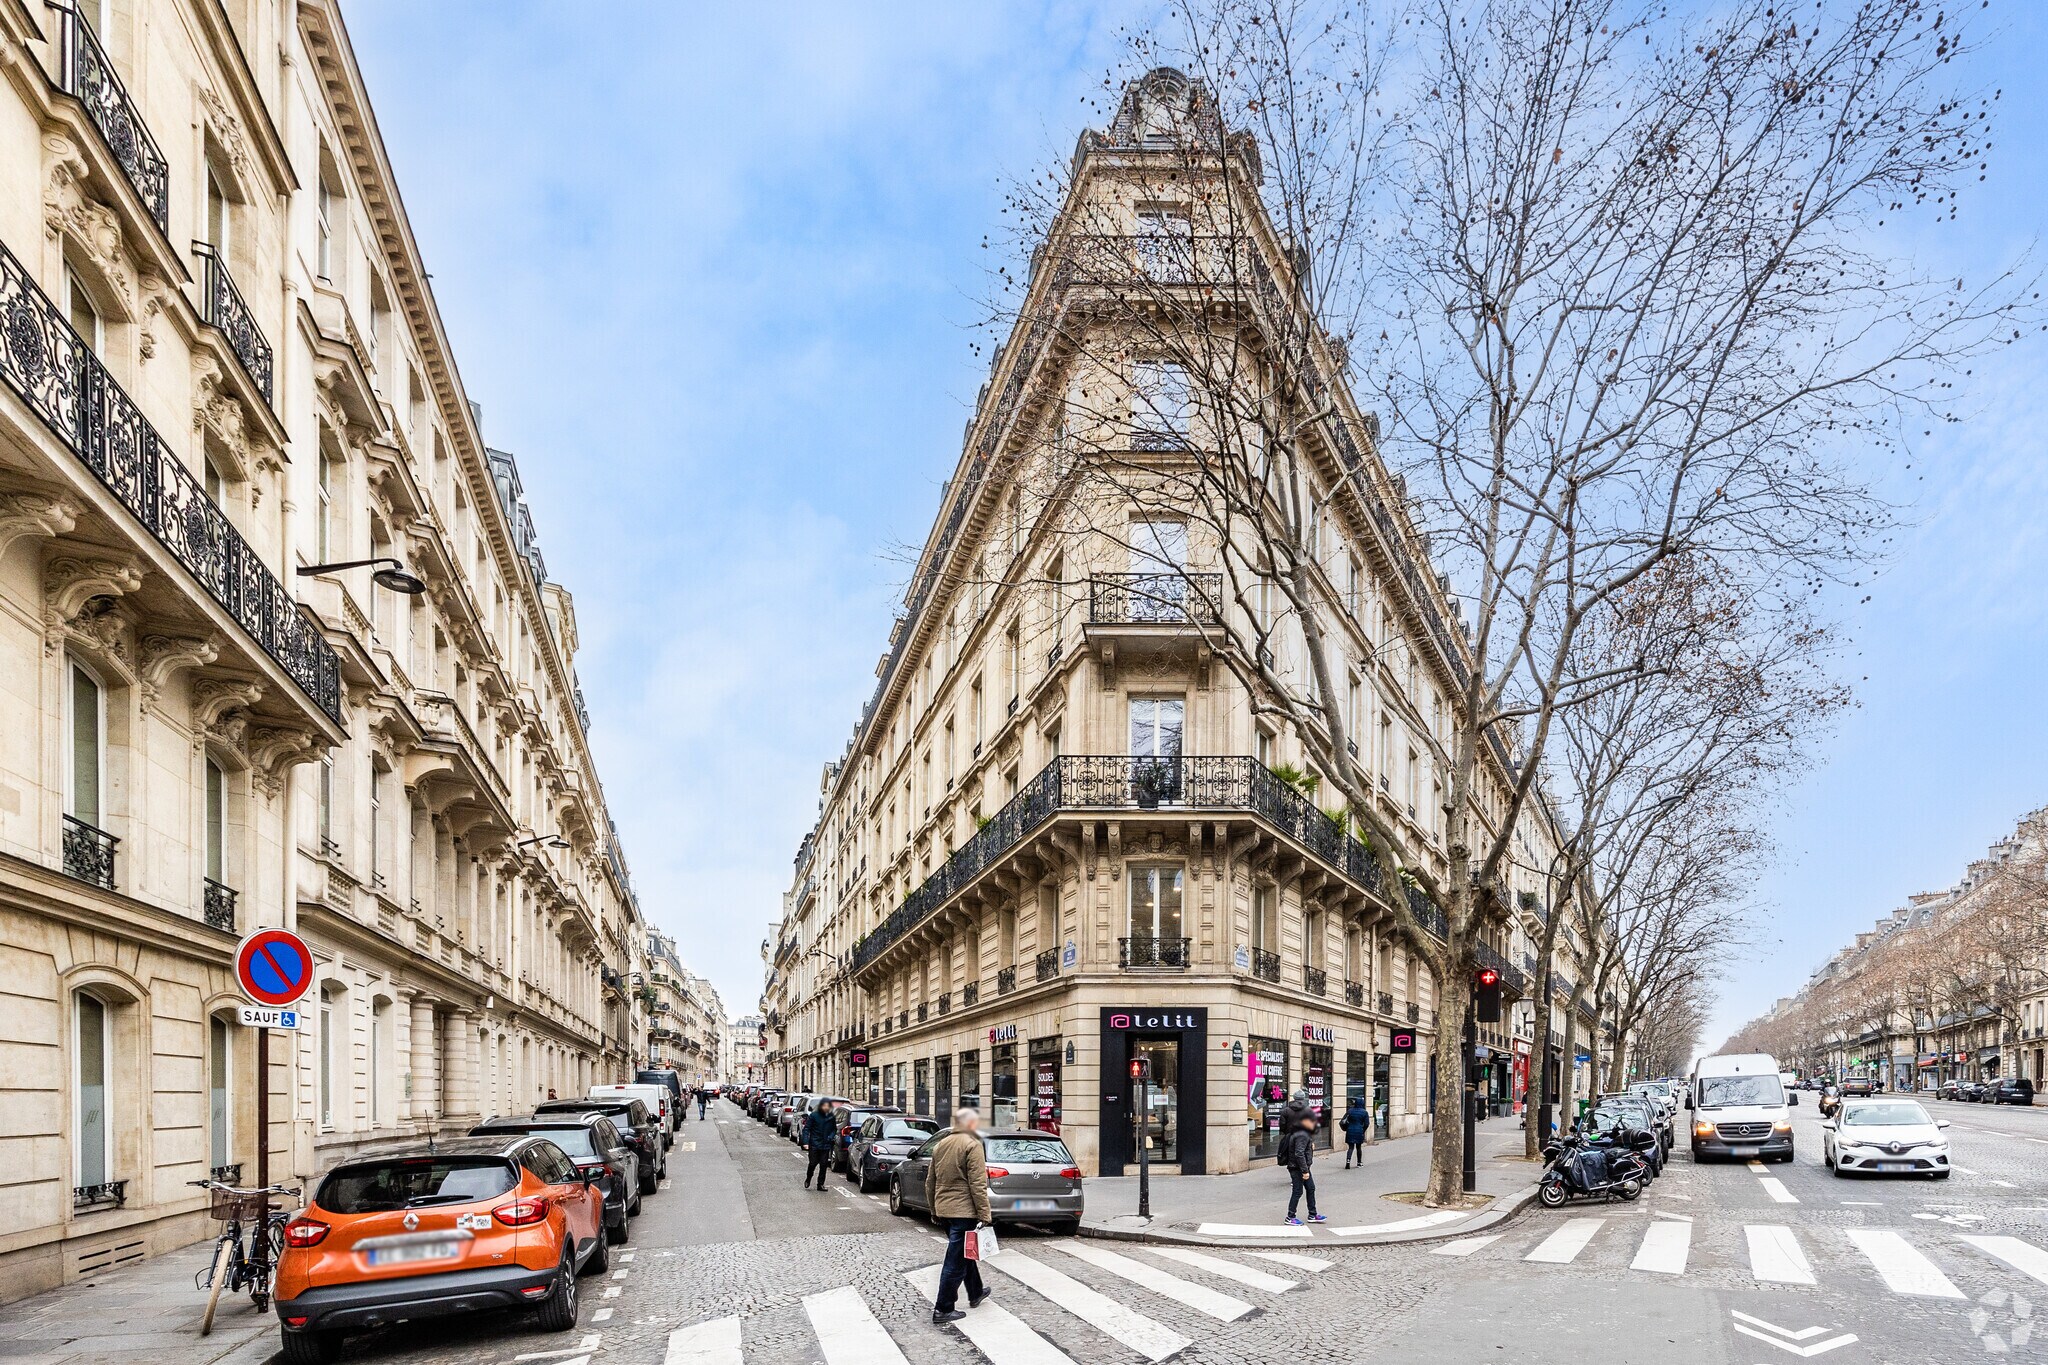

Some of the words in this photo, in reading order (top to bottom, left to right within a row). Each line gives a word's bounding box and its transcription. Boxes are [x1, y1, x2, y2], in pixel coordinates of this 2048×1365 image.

[244, 1011, 279, 1024] SAUF
[1038, 1072, 1053, 1082] SOLDES
[1308, 1076, 1324, 1084] SOLDES
[1038, 1086, 1053, 1094] SOLDES
[1308, 1088, 1324, 1096] SOLDES
[1038, 1098, 1053, 1108] SOLDES
[1308, 1098, 1324, 1106] SOLDES
